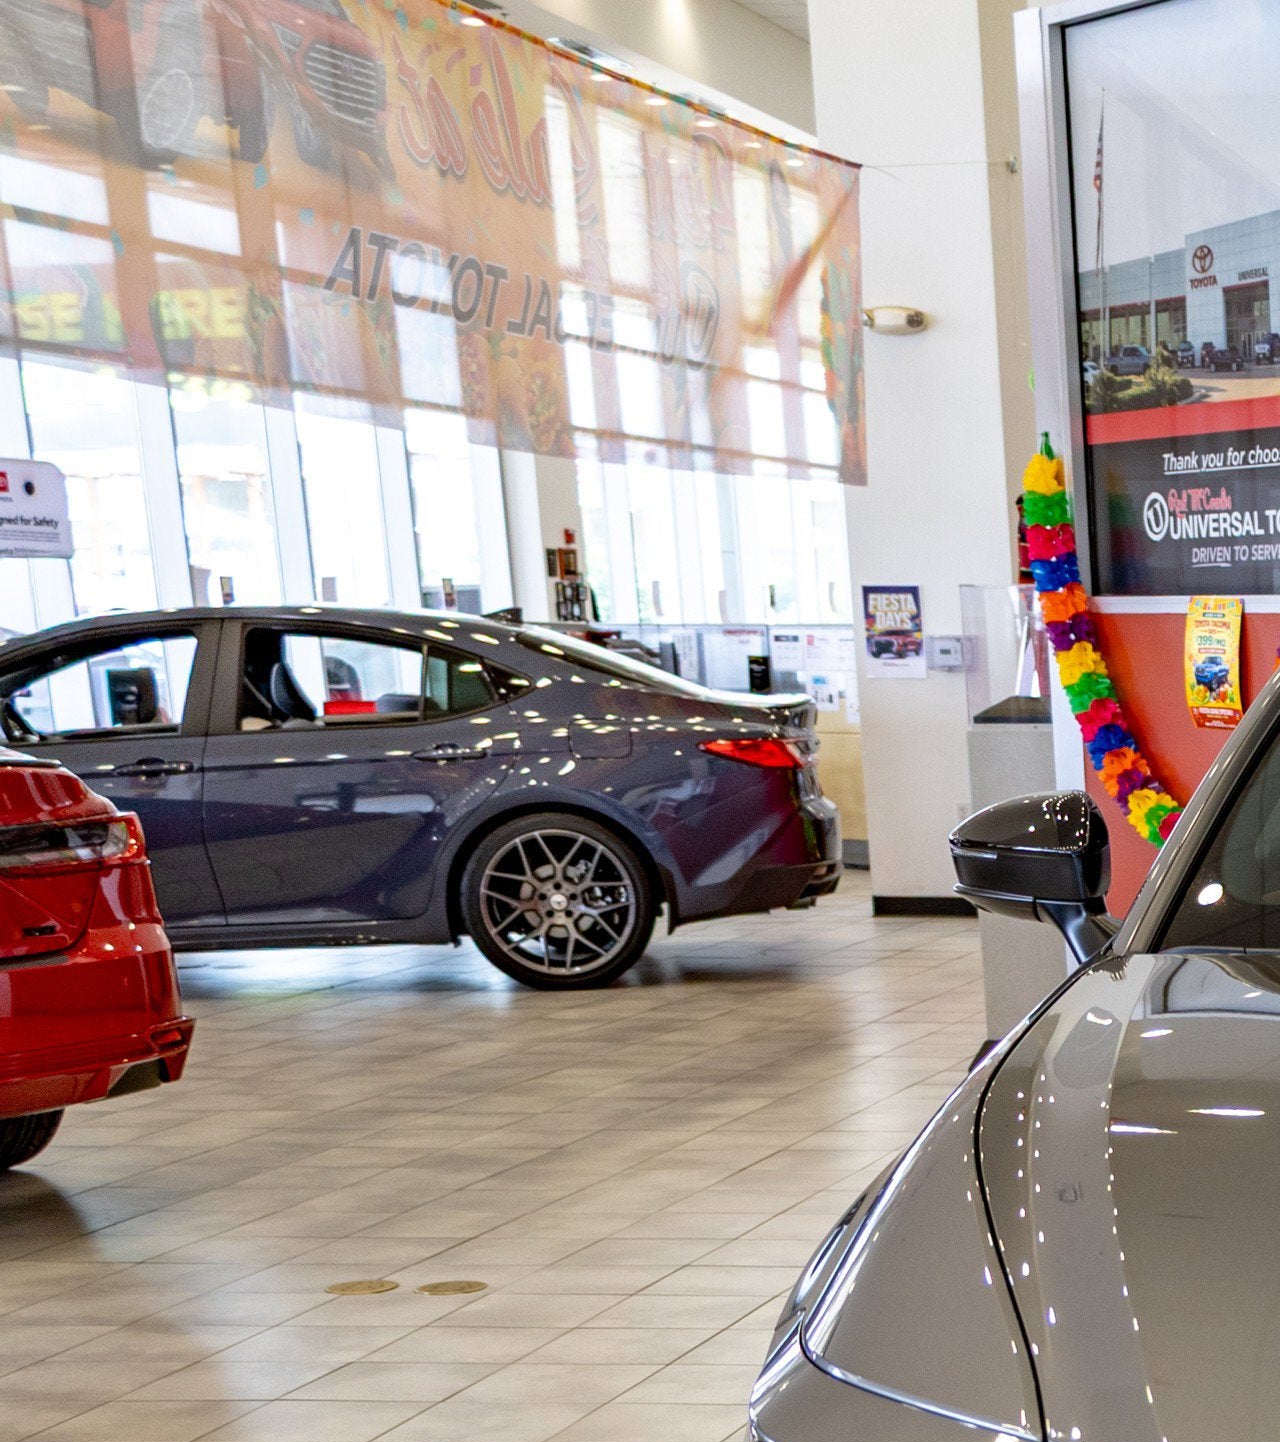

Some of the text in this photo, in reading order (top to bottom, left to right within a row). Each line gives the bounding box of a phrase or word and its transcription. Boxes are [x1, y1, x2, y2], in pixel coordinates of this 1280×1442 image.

[1189, 275, 1218, 290] TOYOTA
[1237, 266, 1269, 281] UNIVERSAL
[1162, 451, 1199, 471] Thank
[1201, 455, 1224, 471] you
[1227, 447, 1247, 466] for
[1169, 510, 1265, 541] UNIVERSAL
[1192, 546, 1232, 563] DRIVEN
[1234, 545, 1250, 561] TO
[868, 593, 917, 614] FIESTA
[876, 611, 912, 630] DAYS
